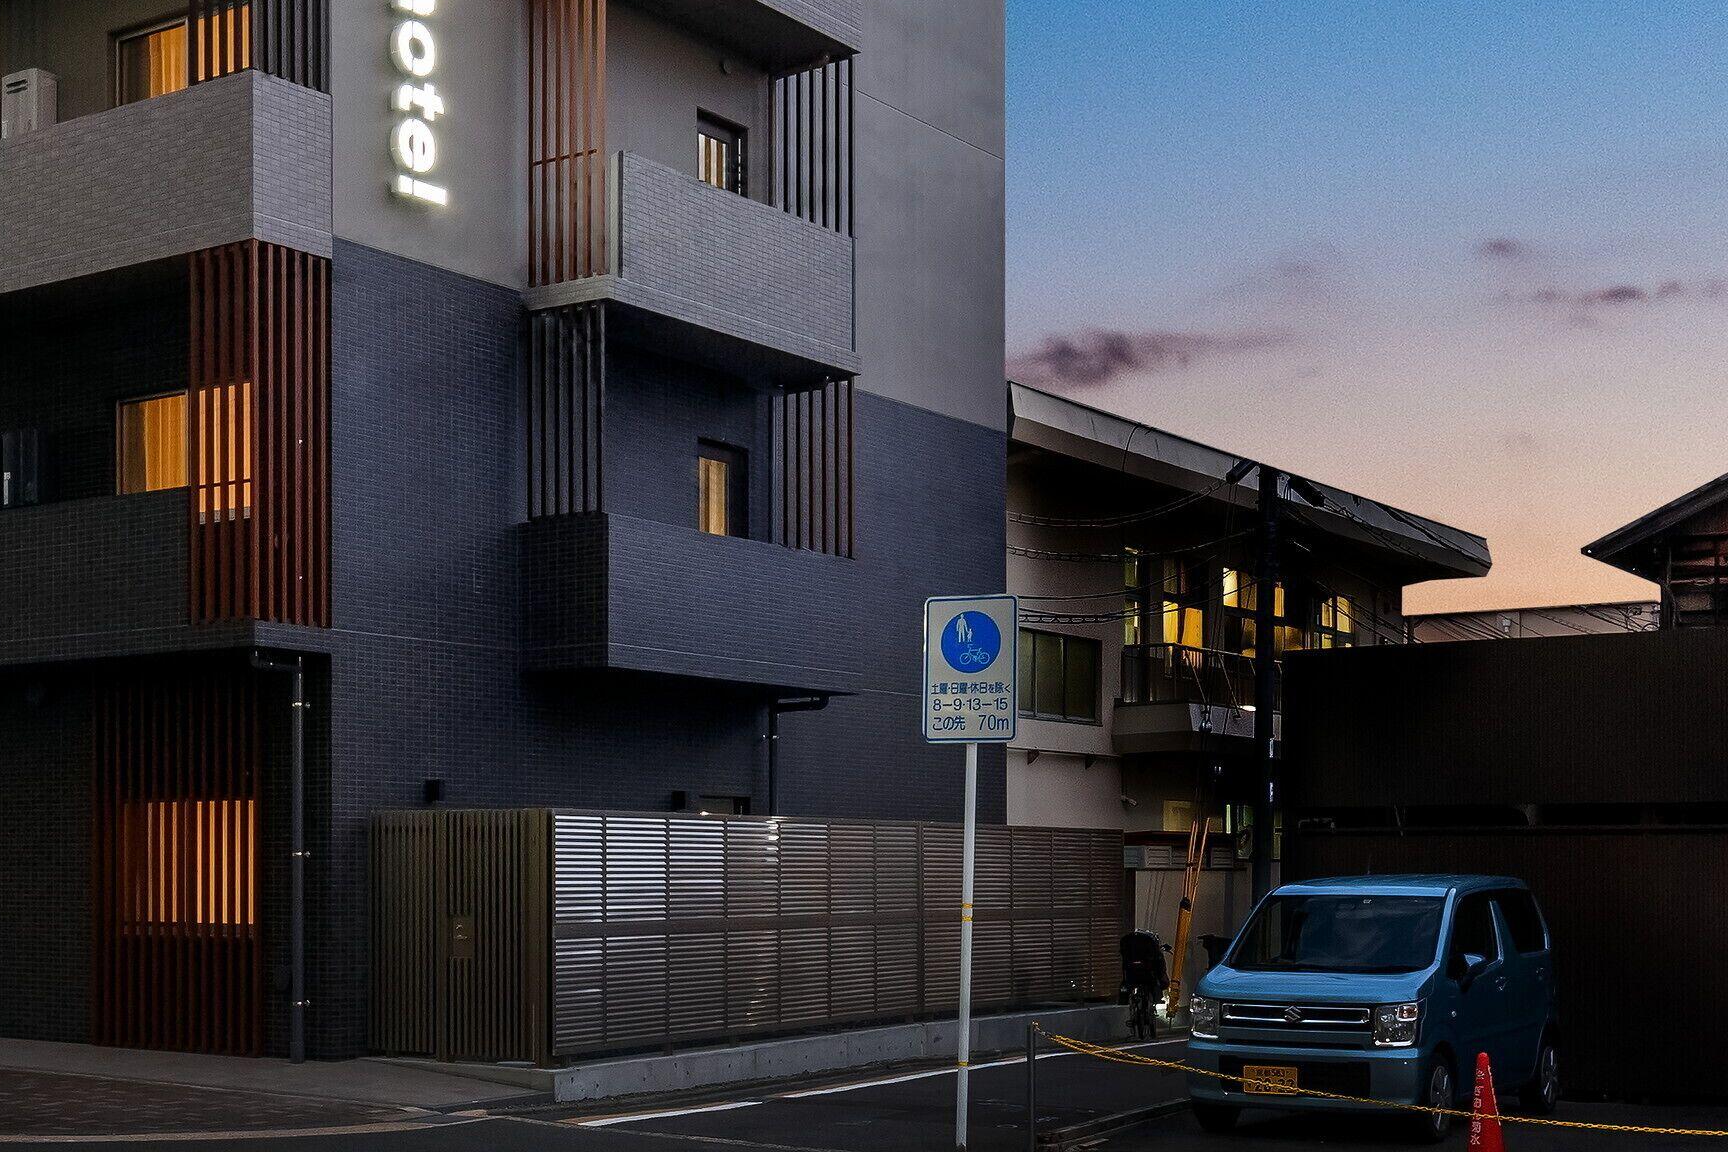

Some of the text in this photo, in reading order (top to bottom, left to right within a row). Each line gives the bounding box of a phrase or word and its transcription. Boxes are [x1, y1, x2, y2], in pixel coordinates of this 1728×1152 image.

[932, 714, 1010, 731] この先 70m
